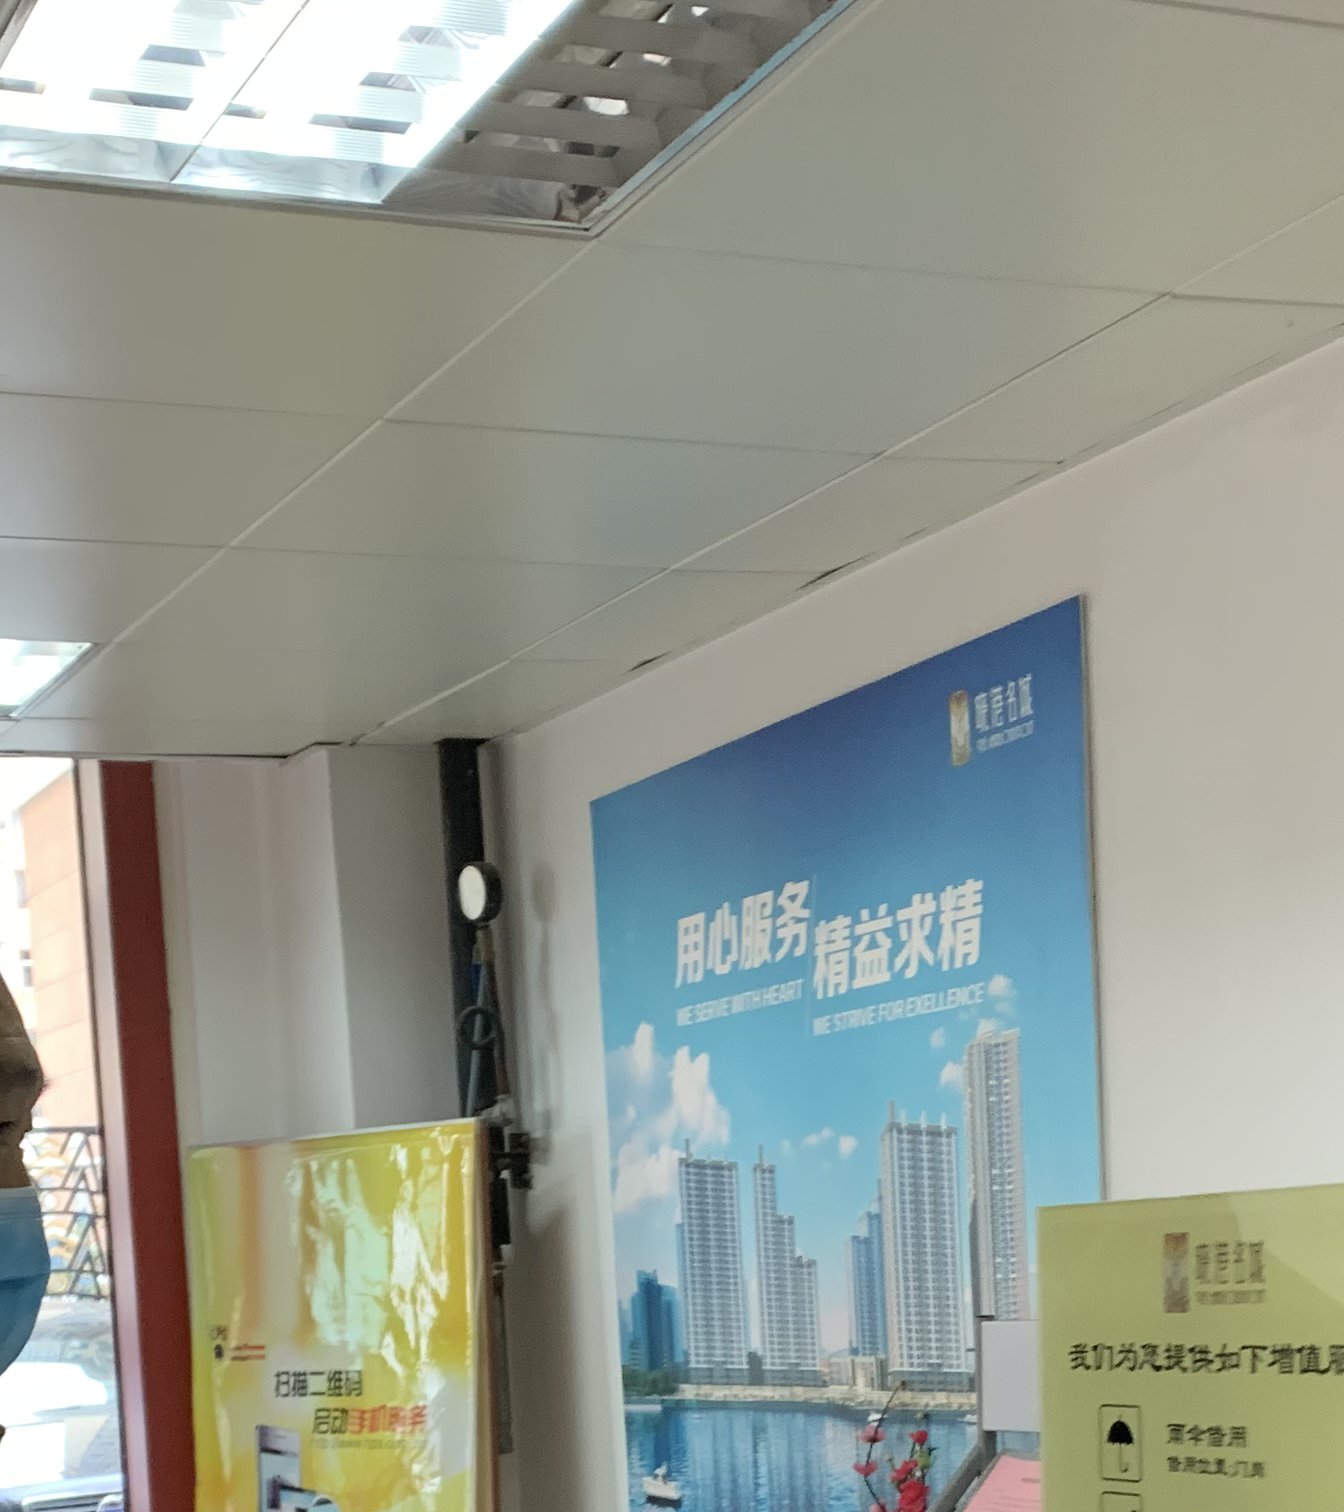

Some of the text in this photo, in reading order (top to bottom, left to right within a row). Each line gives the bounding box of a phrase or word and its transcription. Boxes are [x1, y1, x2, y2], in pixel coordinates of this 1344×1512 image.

[675, 880, 810, 988] 用心服务
[812, 878, 984, 1000] 精益求精
[761, 978, 805, 1008] HEART
[274, 1369, 363, 1397] 扫描二维码
[1166, 1423, 1248, 1449] 雨伞借用
